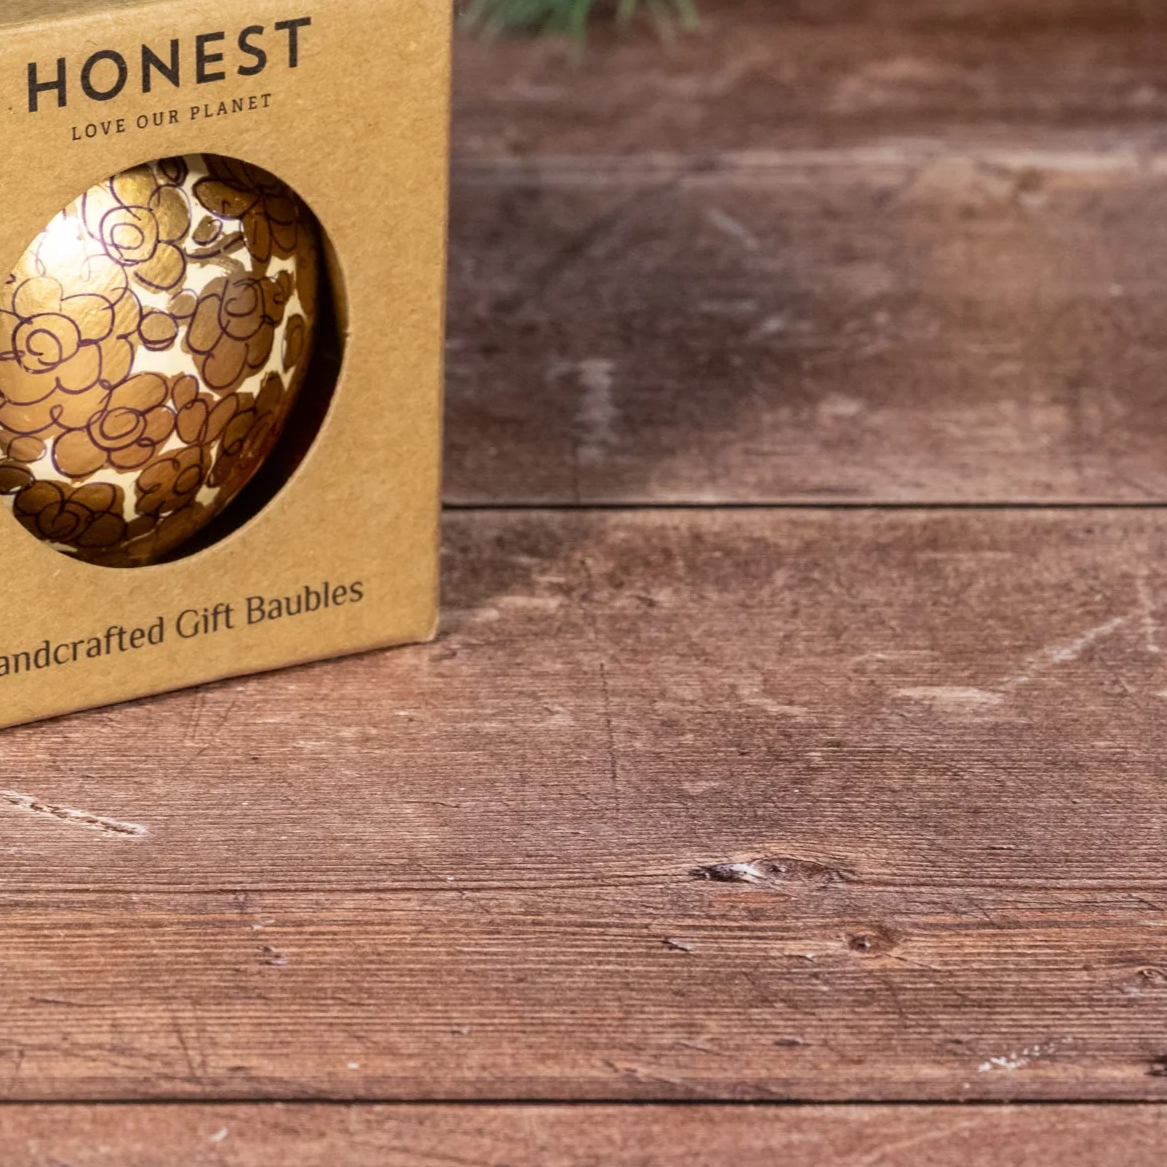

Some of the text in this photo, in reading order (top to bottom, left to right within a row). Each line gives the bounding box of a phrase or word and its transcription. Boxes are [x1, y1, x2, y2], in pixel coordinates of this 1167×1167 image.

[27, 16, 312, 113] HONEST
[71, 93, 273, 141] LOVE OUR PLANET
[175, 602, 235, 639] Gift
[245, 580, 365, 625] Baubles
